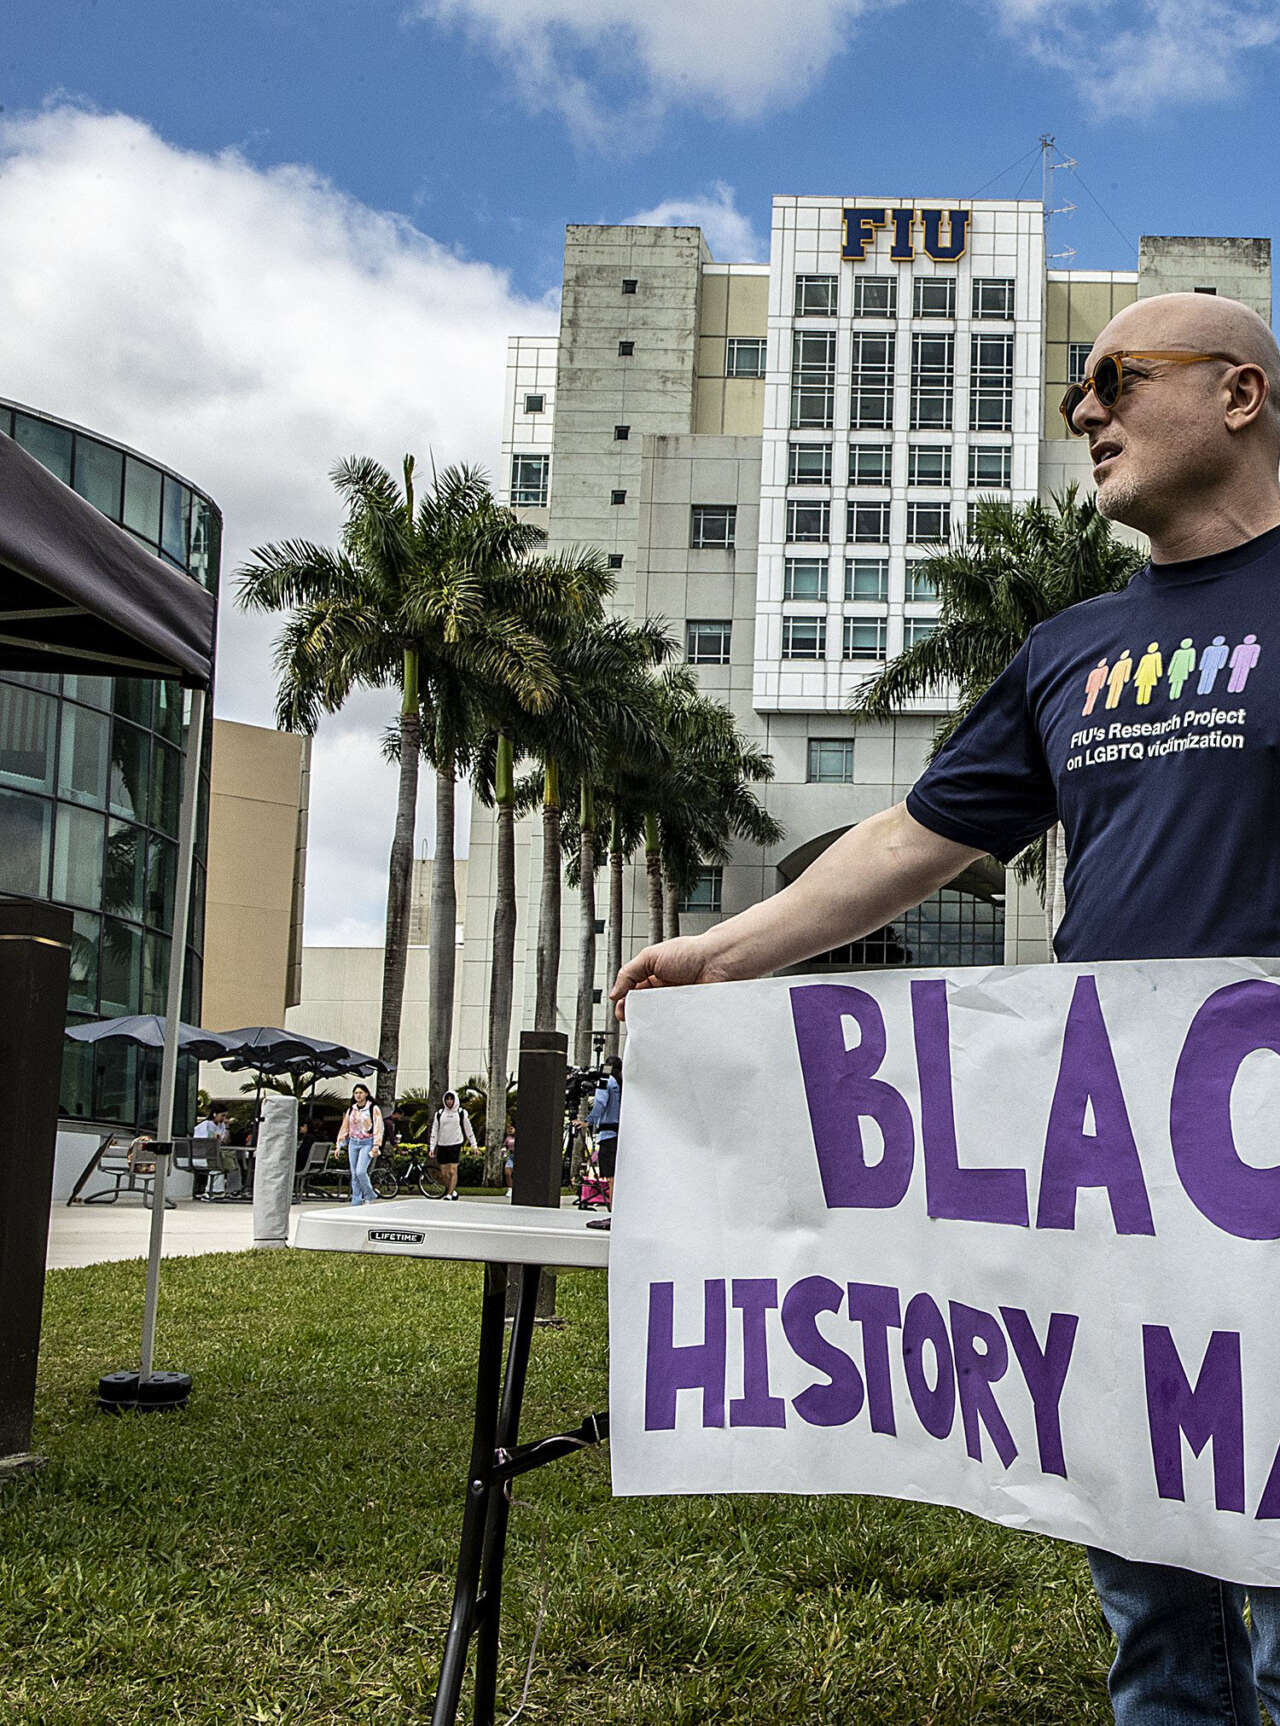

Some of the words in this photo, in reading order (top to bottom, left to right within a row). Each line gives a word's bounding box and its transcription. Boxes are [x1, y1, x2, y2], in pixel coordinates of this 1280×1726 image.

[841, 208, 971, 262] FIU
[1070, 727, 1105, 749] FIU's
[1108, 714, 1181, 740] Research
[1184, 708, 1247, 728] Project
[1066, 755, 1082, 771] on
[1085, 743, 1144, 766] LGBTQ
[1147, 731, 1244, 758] victimization
[375, 1232, 418, 1242] LIFETIME
[644, 1276, 1078, 1478] HISTORY
